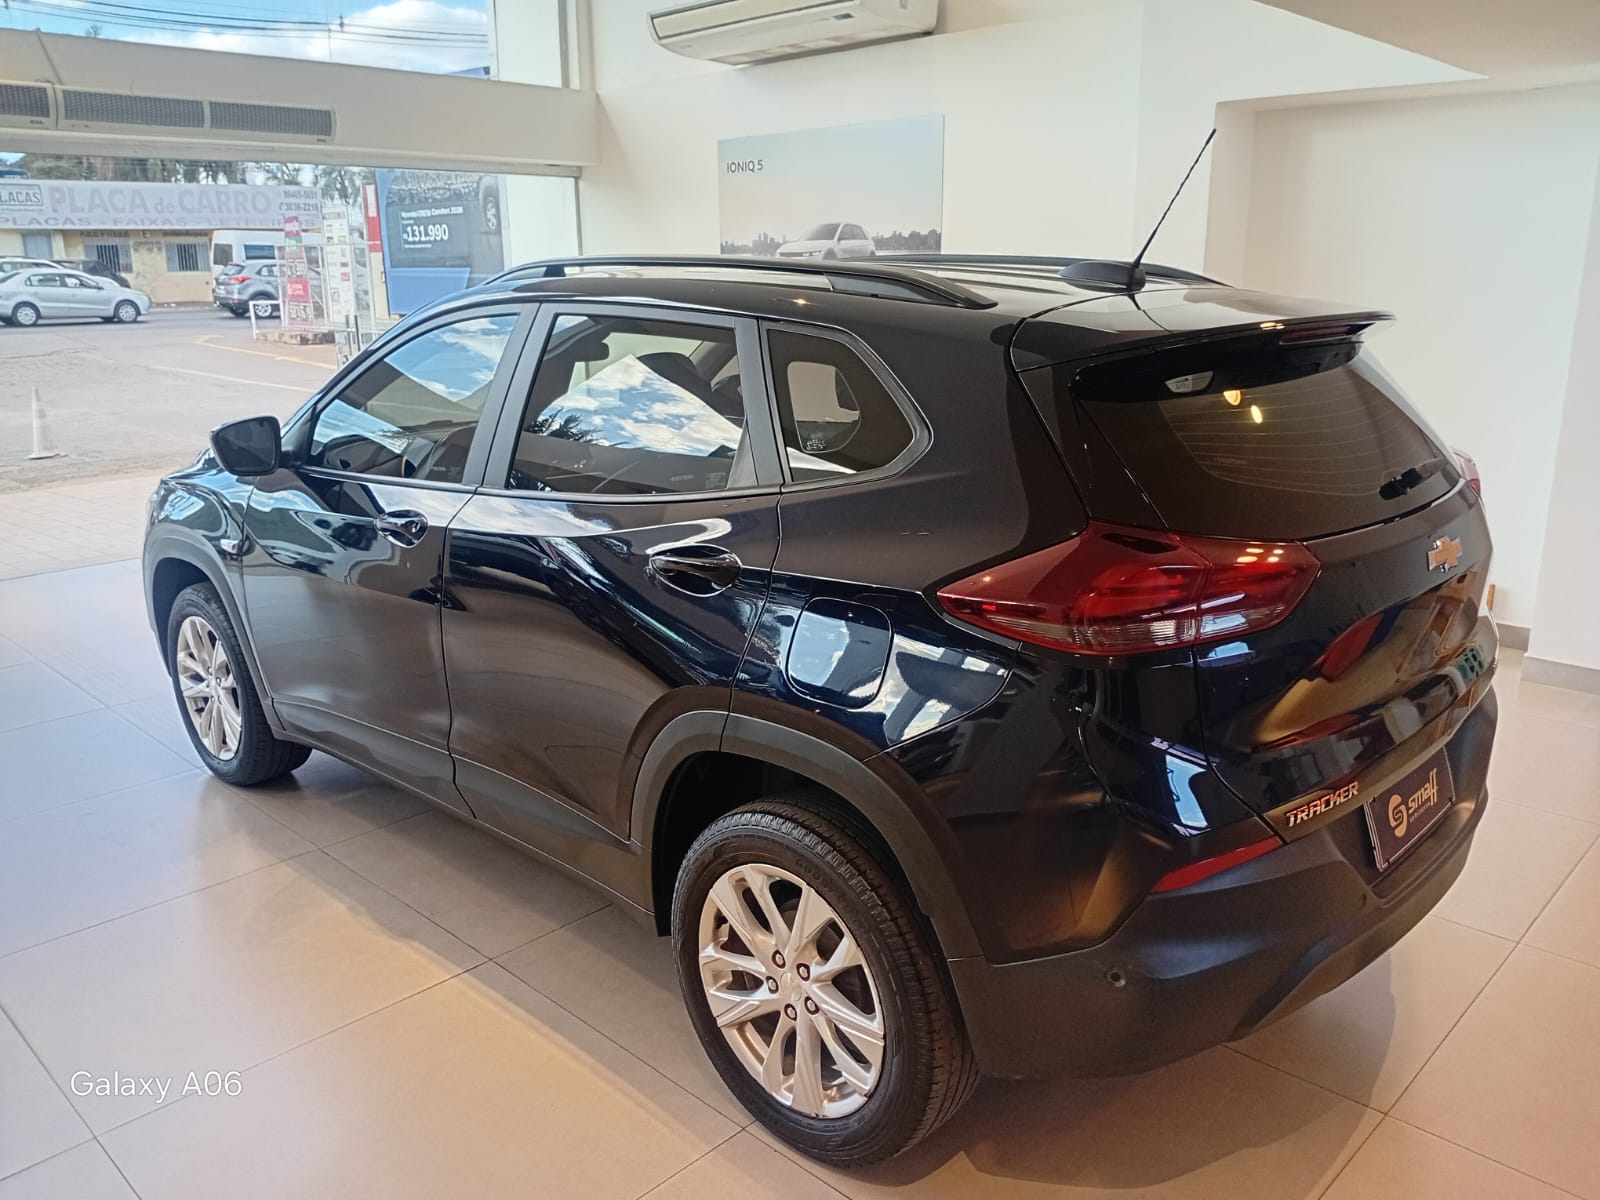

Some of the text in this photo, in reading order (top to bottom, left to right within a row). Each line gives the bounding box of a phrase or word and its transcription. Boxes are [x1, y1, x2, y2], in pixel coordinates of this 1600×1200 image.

[726, 159, 764, 174] IONIQ 5
[48, 186, 271, 214] PLACA de CARRO
[0, 216, 91, 227] PLACAS
[112, 217, 188, 227] FAIXAS
[406, 224, 449, 242] 131.990
[1285, 780, 1360, 828] TRACKER
